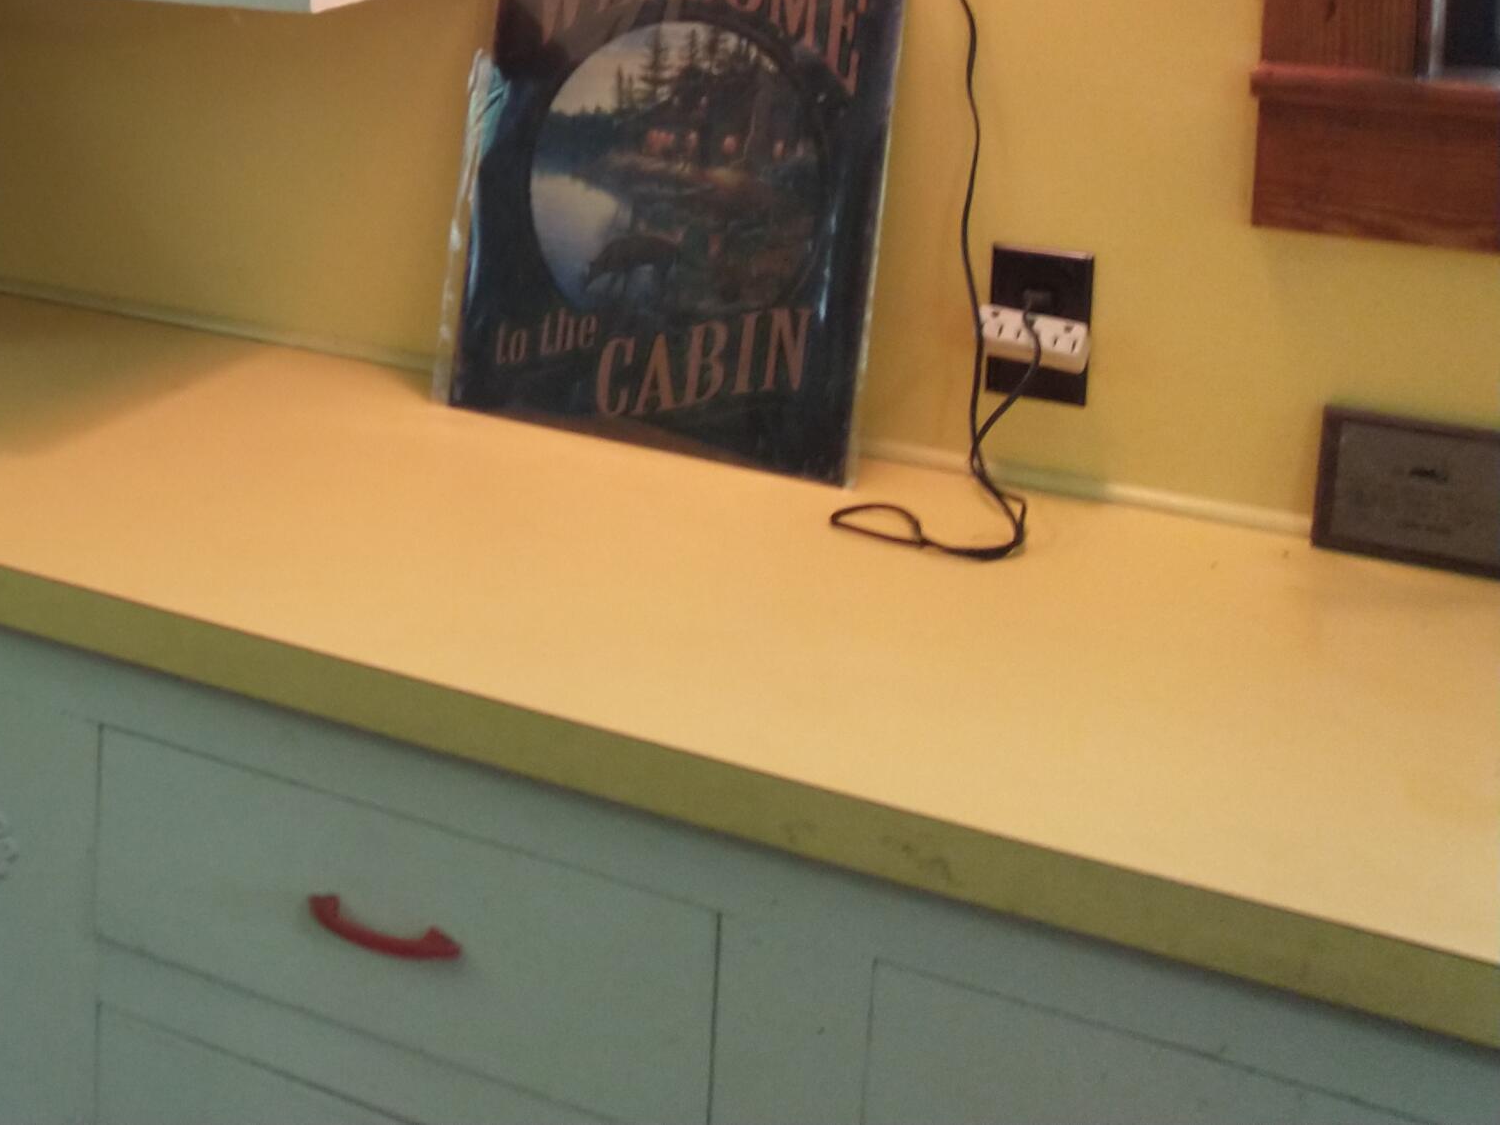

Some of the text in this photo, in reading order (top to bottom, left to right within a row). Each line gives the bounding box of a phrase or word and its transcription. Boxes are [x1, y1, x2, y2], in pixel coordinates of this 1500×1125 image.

[495, 307, 814, 417] to the CABIN
